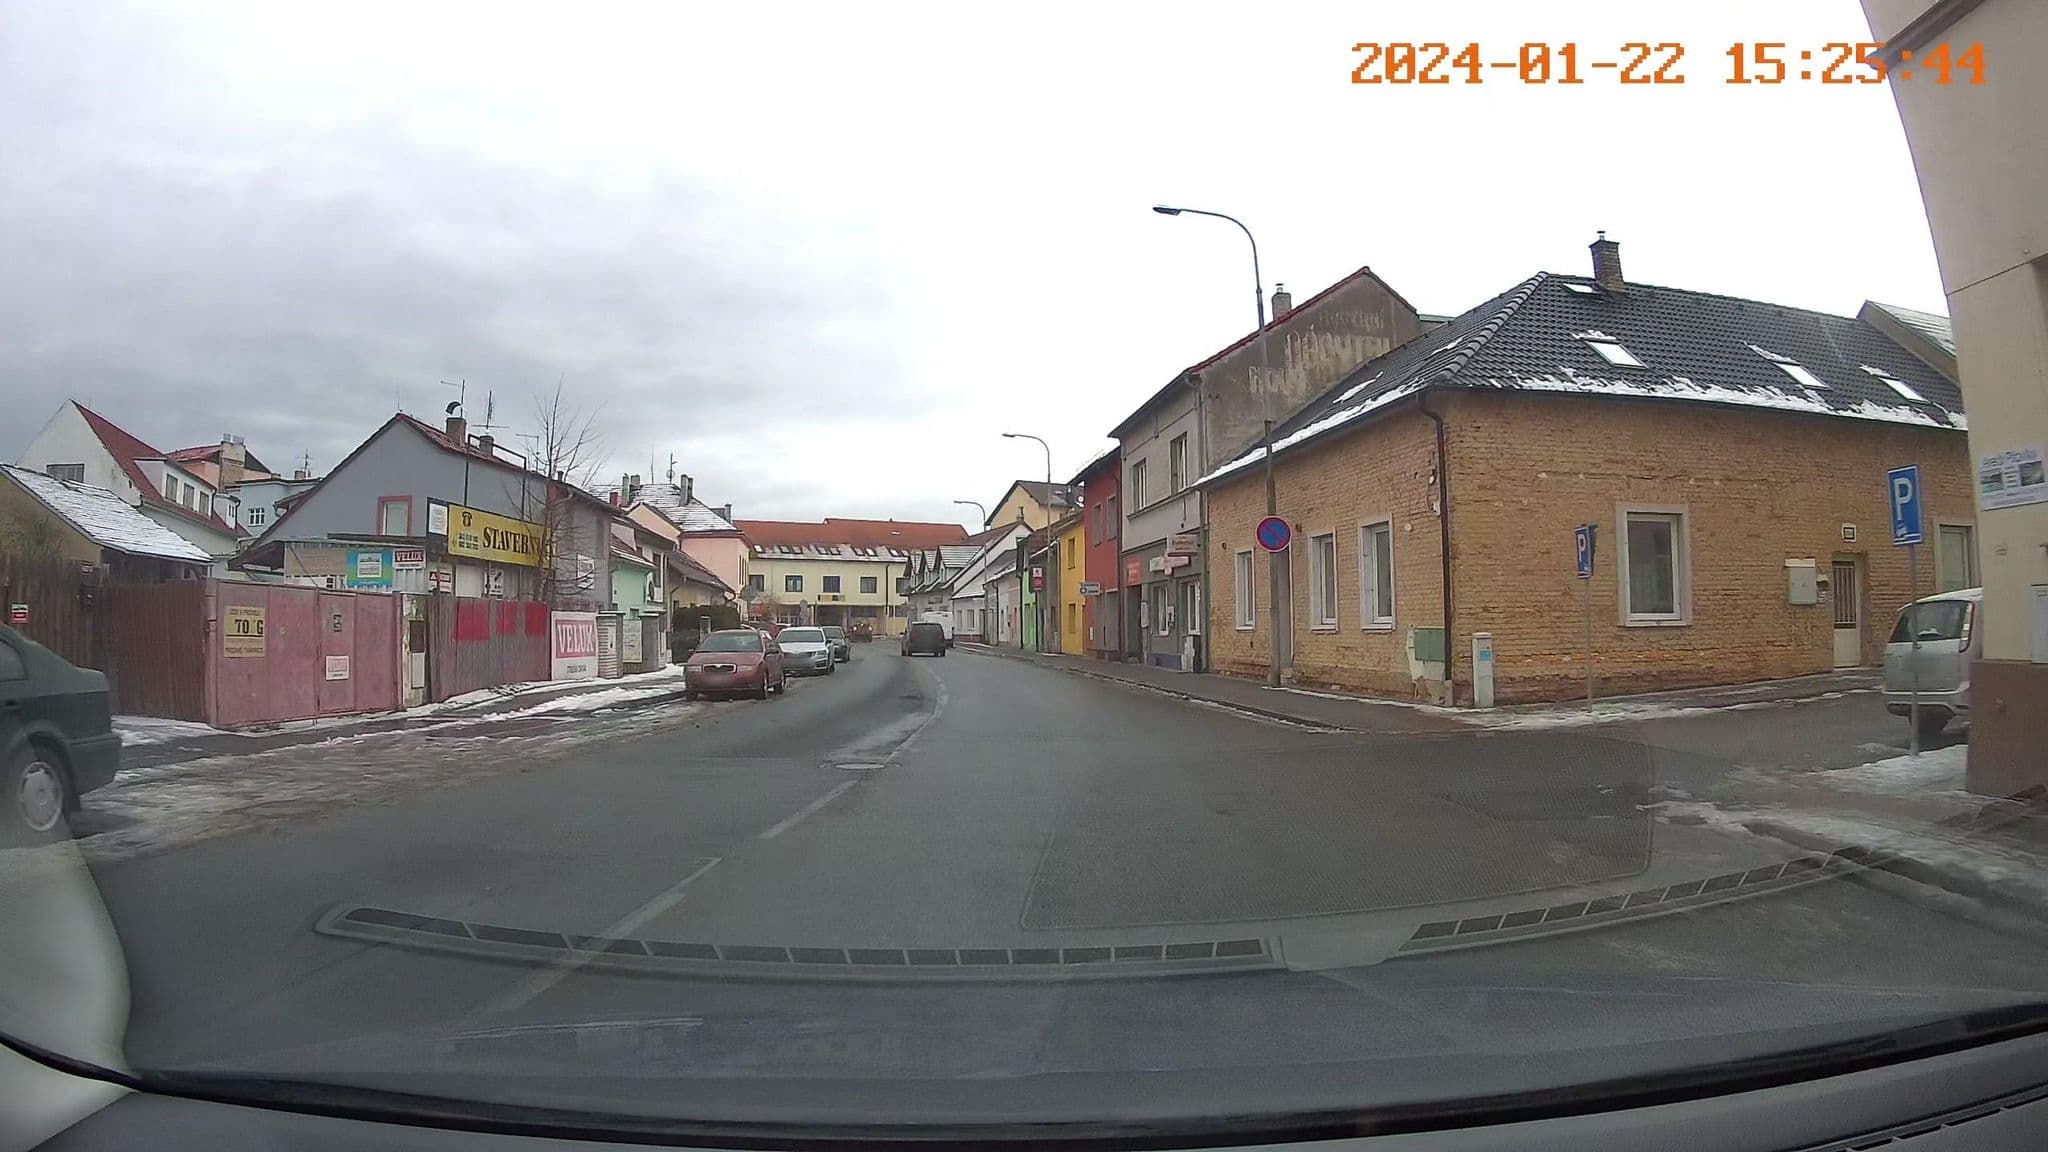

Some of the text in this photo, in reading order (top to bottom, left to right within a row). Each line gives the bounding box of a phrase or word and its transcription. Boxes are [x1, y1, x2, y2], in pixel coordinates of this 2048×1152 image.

[1894, 477, 1913, 521] P
[396, 551, 422, 561] VELUX
[1577, 533, 1587, 563] P
[557, 623, 595, 655] VELUX
